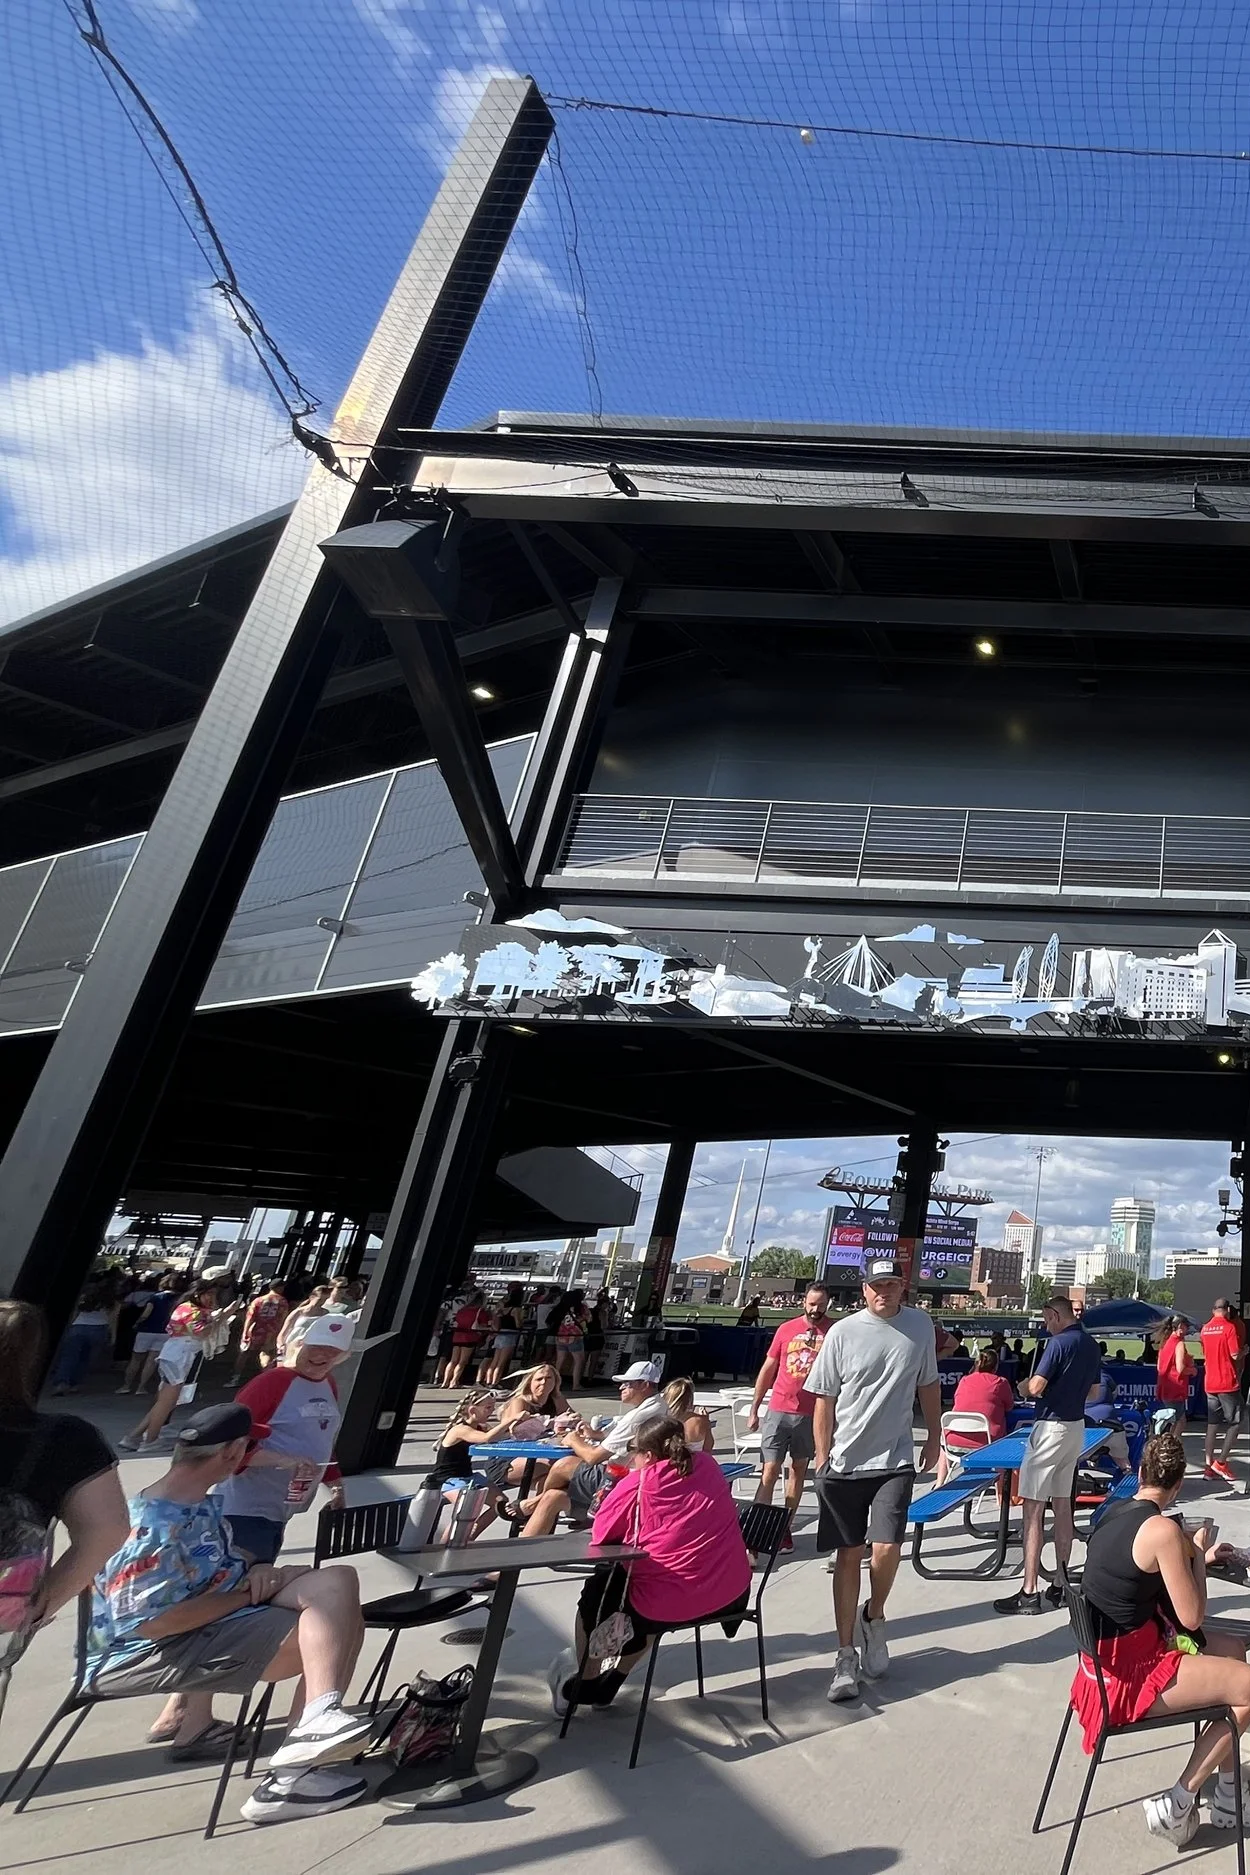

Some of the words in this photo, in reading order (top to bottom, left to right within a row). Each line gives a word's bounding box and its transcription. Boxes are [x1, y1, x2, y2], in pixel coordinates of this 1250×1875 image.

[841, 1170, 892, 1191] EQUIT
[957, 1184, 994, 1202] PARK
[867, 1231, 893, 1242] FOLLOW
[933, 1236, 952, 1246] SOCIAL
[836, 1251, 861, 1260] evergy
